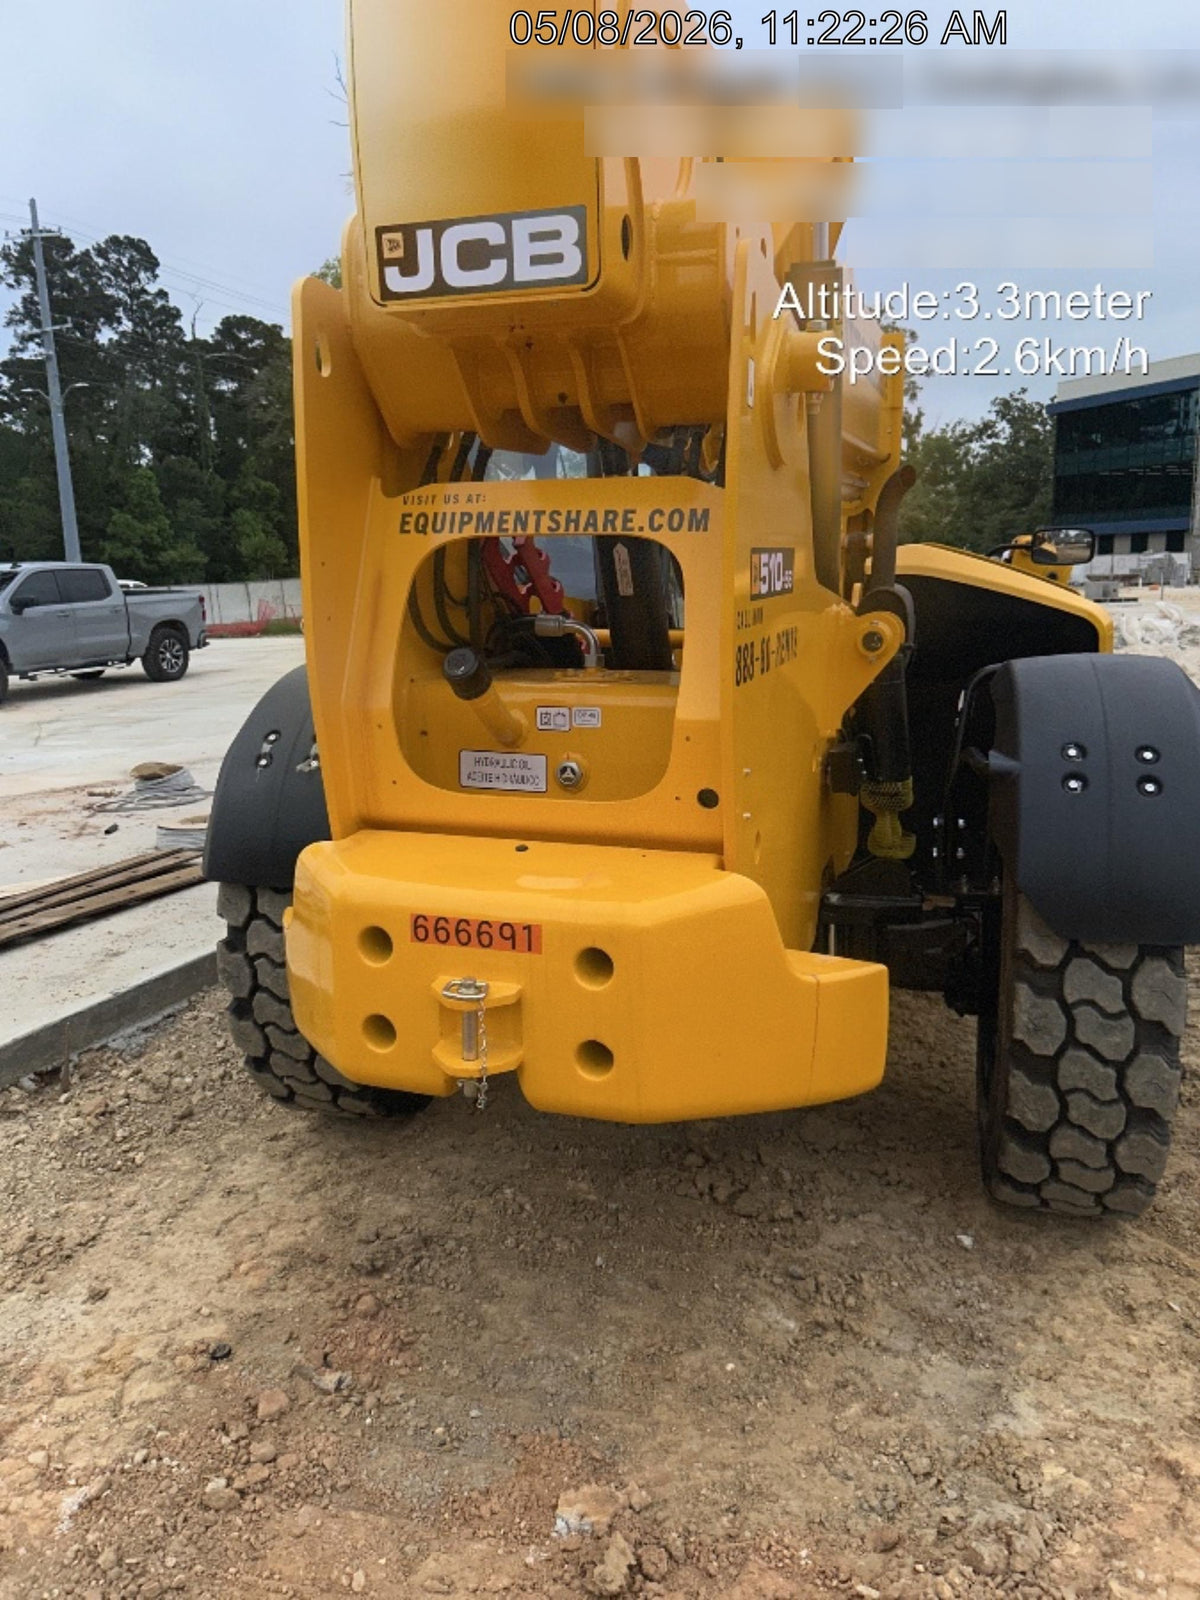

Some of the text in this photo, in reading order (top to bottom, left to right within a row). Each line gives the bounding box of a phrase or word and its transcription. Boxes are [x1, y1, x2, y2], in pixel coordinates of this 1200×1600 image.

[383, 214, 582, 293] JCB
[402, 493, 486, 505] VISIT US AT:
[399, 507, 711, 536] EQUIPMENTSHARE.COM
[412, 914, 533, 953] 666691
